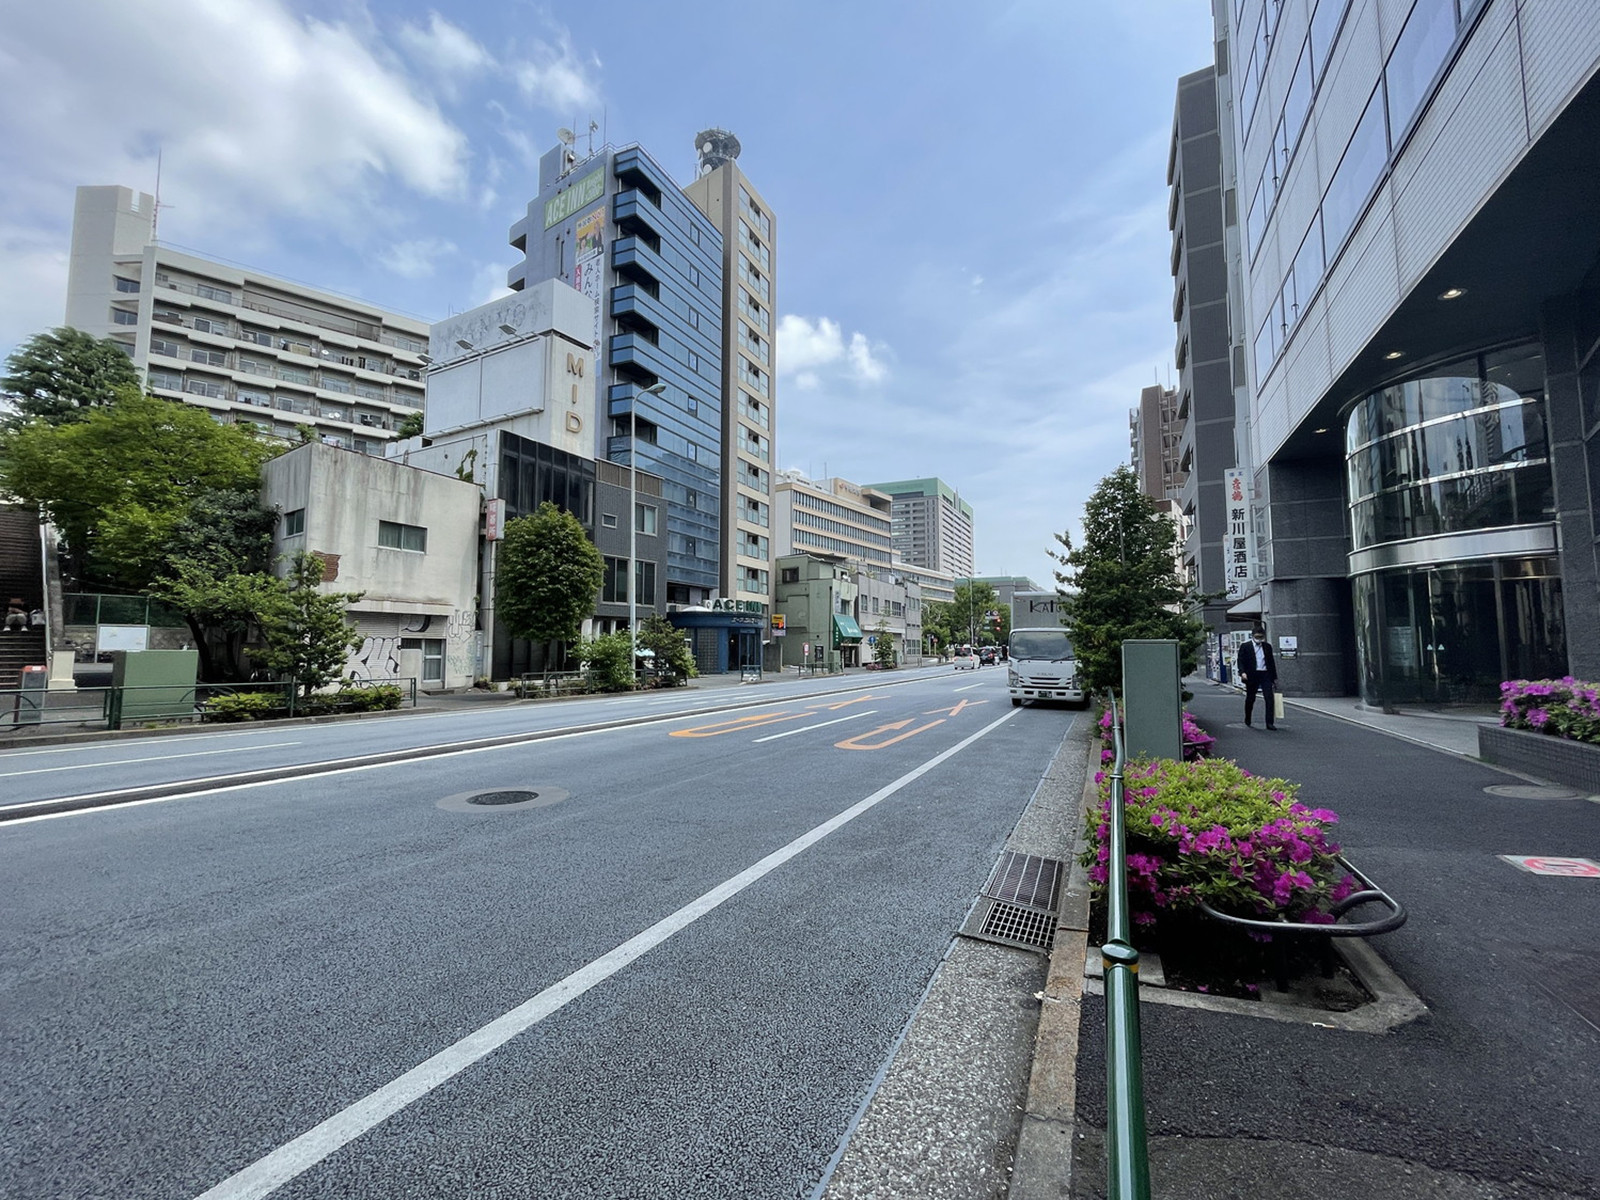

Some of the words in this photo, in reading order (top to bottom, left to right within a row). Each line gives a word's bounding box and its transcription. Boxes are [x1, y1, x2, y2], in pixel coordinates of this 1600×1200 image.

[545, 194, 566, 227] ACE
[566, 181, 586, 214] INN
[1231, 508, 1248, 578] 新川屋酒店
[713, 598, 744, 612] ACE
